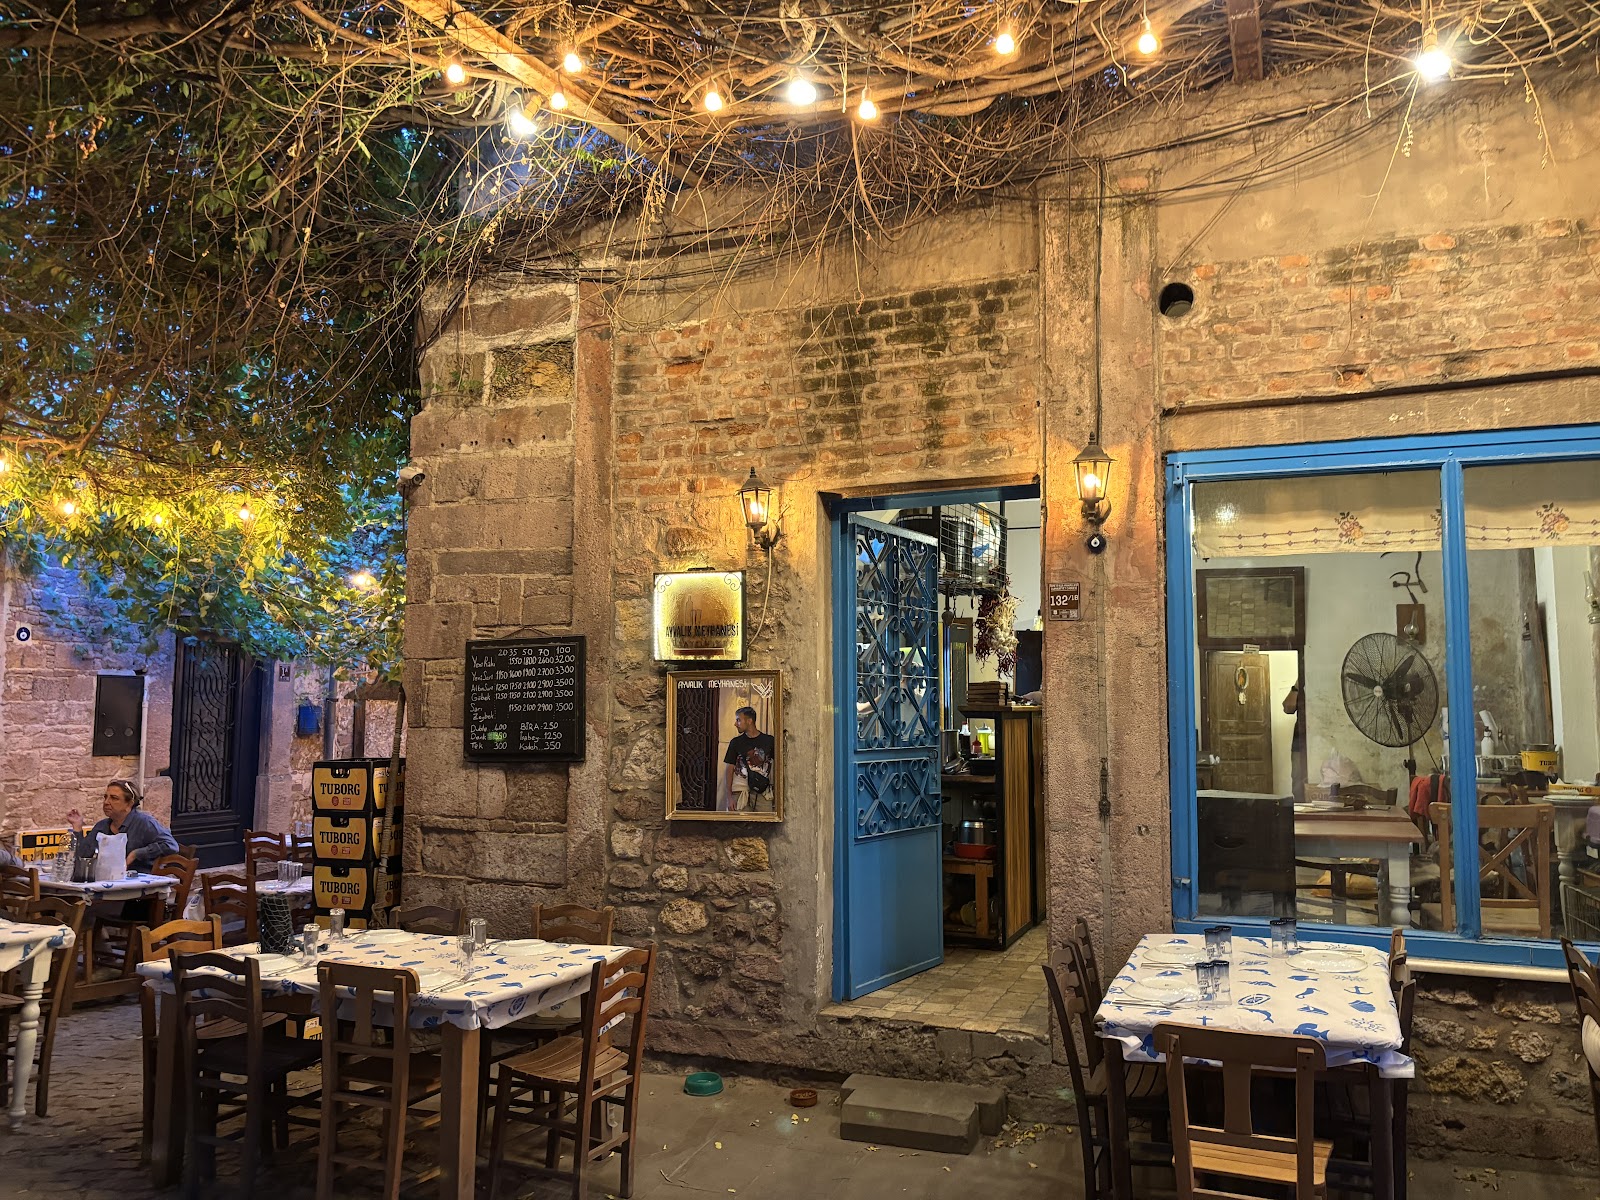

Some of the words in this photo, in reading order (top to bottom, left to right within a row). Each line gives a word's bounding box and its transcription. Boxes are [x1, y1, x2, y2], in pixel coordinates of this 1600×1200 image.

[665, 626, 693, 637] AYVALIK
[522, 648, 533, 656] 50
[538, 648, 550, 657] 70
[556, 646, 570, 654] 100
[509, 657, 522, 665] 1550
[537, 656, 555, 664] 2600
[555, 654, 576, 664] 3200
[496, 670, 508, 680] 1150
[537, 667, 555, 676] 2700
[555, 665, 575, 675] 3300
[496, 683, 509, 691] 1250
[554, 677, 574, 687] 3500
[677, 680, 703, 689] AYVALIK
[495, 692, 508, 700] 1250
[522, 690, 537, 699] 2100
[537, 690, 553, 699] 2900
[555, 689, 574, 698] 3500
[522, 703, 537, 712] 2100
[537, 703, 553, 712] 2900
[555, 702, 574, 712] 3500
[544, 731, 563, 740] 1250
[493, 741, 508, 750] 300
[543, 740, 561, 751] 350
[320, 783, 360, 796] TUBORG
[320, 831, 360, 845] TUBORG
[320, 881, 360, 895] TUBORG
